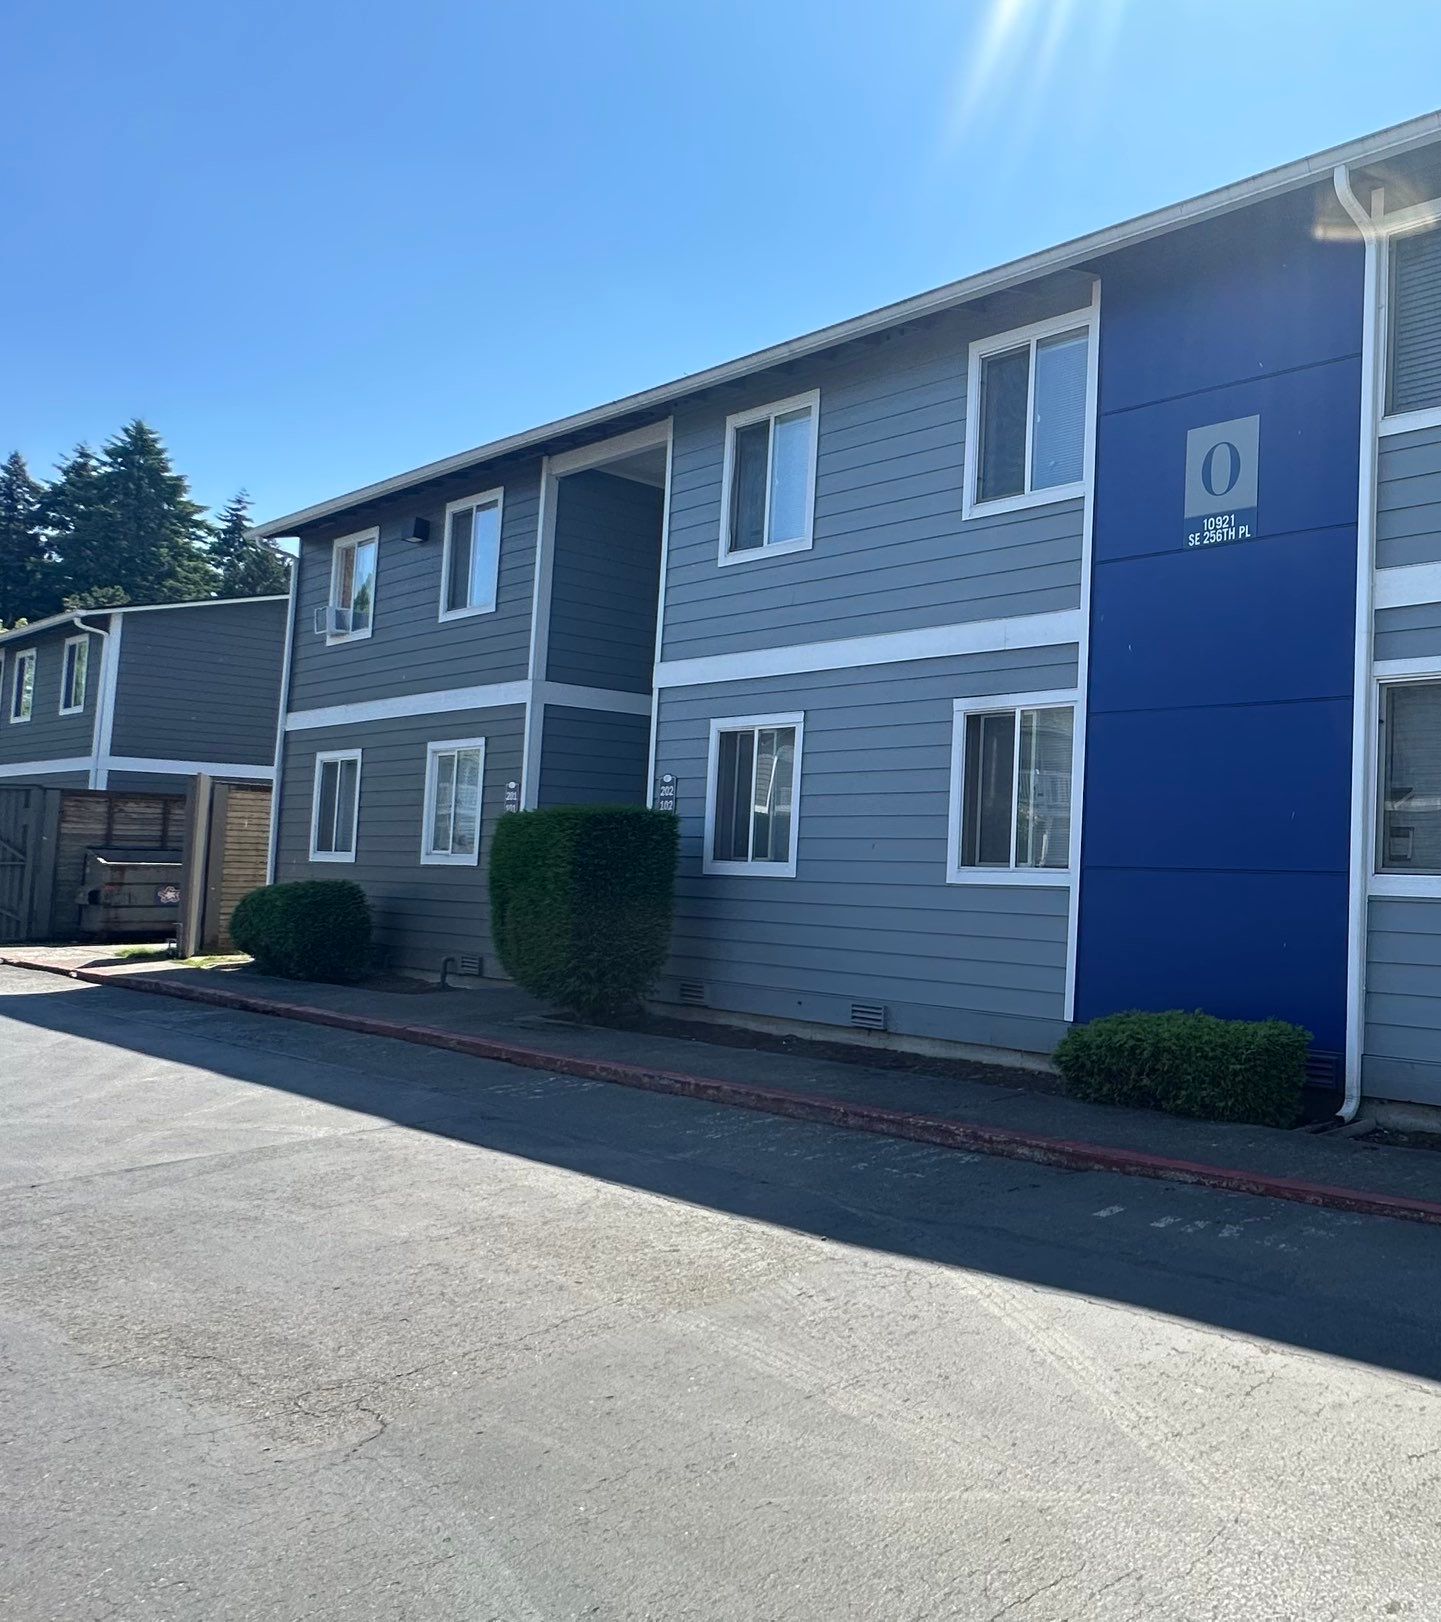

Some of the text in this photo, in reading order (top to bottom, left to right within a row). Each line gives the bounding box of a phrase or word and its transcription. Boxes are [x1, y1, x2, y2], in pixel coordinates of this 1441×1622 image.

[1203, 514, 1235, 531] 10921
[1188, 525, 1251, 547] SE 256TH PL
[660, 785, 674, 797] 202
[659, 800, 673, 811] 102
